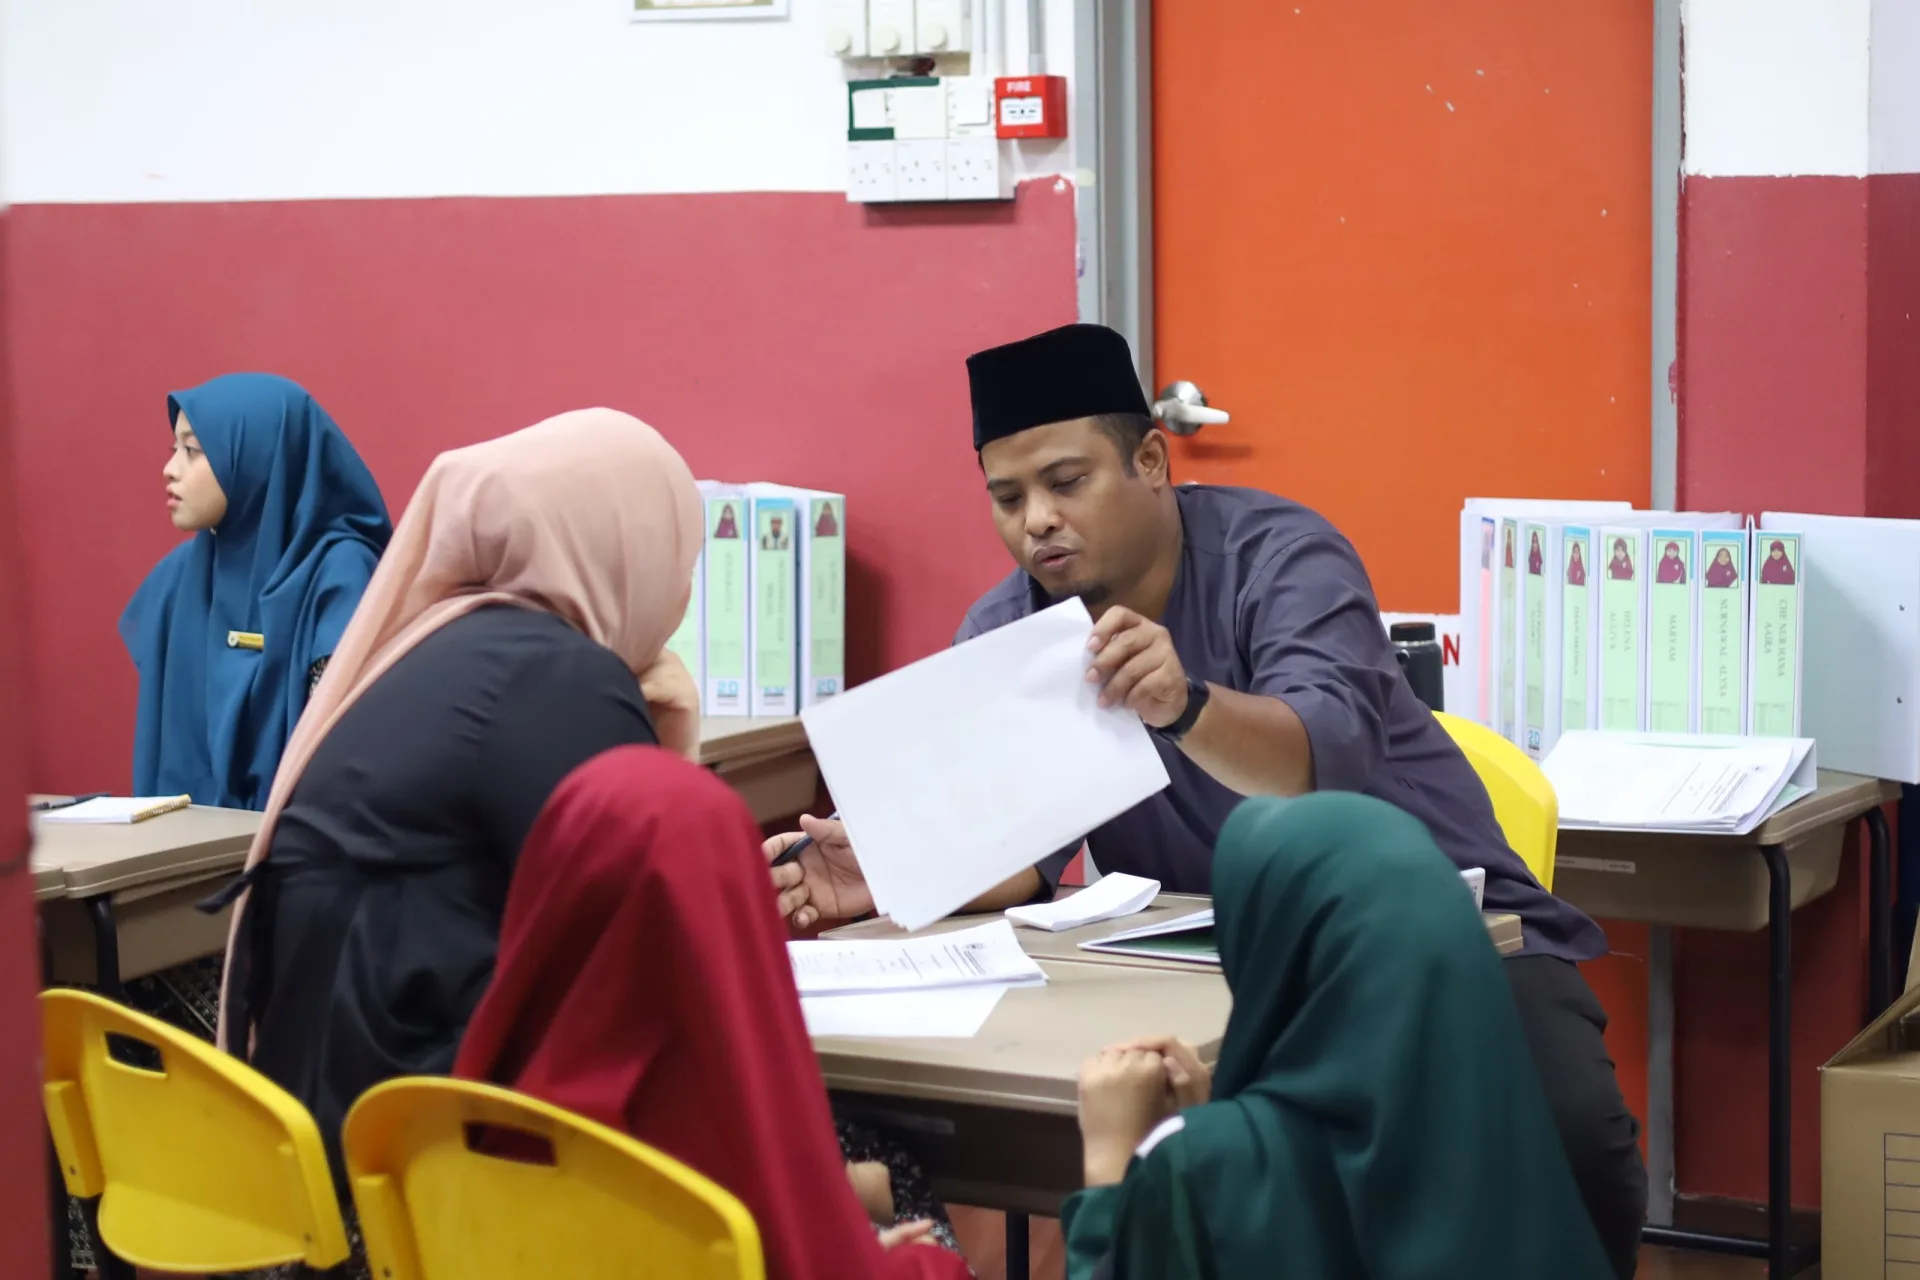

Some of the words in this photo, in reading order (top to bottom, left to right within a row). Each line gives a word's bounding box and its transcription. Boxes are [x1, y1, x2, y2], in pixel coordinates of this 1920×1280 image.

[1007, 80, 1031, 93] FIRE
[1778, 598, 1787, 620] CHE
[1623, 610, 1631, 652] HELENA
[1669, 614, 1677, 662] MARYAM
[1778, 623, 1787, 644] NUR
[1777, 647, 1787, 678] HANA
[1719, 664, 1728, 697] ALYSA
